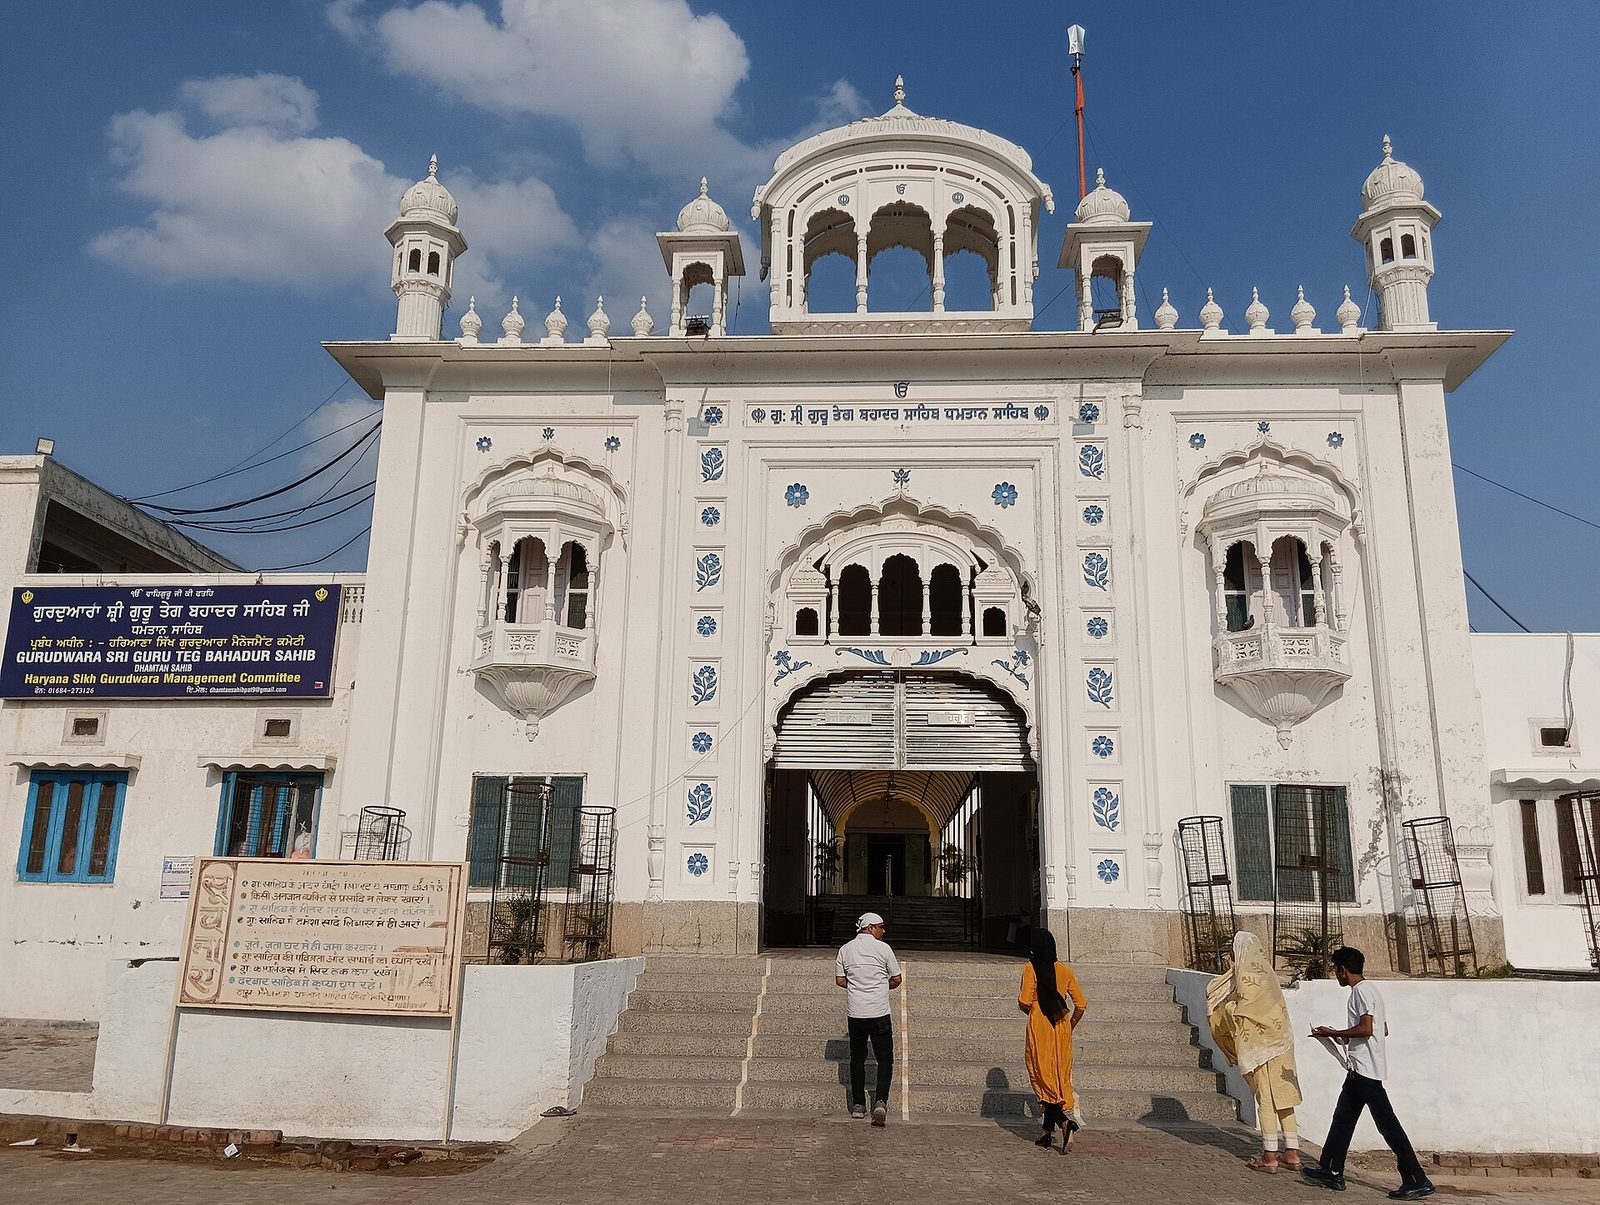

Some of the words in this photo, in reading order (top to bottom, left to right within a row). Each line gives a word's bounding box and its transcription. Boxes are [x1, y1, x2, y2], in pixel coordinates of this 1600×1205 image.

[833, 404, 854, 421] ਤੇਗ
[903, 402, 940, 421] ਸਾਹਿਬ
[992, 402, 1029, 419] ਸਾਹਿਬ
[129, 605, 154, 624] ਗੁਰੂ
[159, 601, 183, 619] ਤੇਗ
[188, 604, 239, 618] ਬਹਾਦਰ
[243, 599, 288, 618] ਸਾਹਿਬ
[292, 599, 311, 617] ਜੀ
[131, 625, 168, 635] ਧਮਤਾਨ
[171, 621, 204, 635] ਸਾਹਿਬ
[56, 635, 85, 648] ਅਧੀਨ
[108, 635, 152, 648] ਹਰਿਆਣਾ
[155, 635, 176, 647] ਸਿੱਖ
[179, 637, 229, 650] ਗੁਰਦੁਆਰਾ
[276, 633, 305, 647] ਕਮੇਟੀ
[16, 651, 102, 663] GURUDWARA
[106, 651, 129, 663] SRI
[133, 651, 171, 663] GURU
[176, 650, 201, 662] TEG
[205, 650, 271, 662] BAHADUR
[275, 649, 316, 661] SAHIB
[134, 664, 169, 673] DHAMTAN
[171, 663, 193, 672] SAHIB
[25, 673, 69, 686] Haryana
[72, 673, 97, 684] Sikh
[100, 673, 160, 684] Gurudwara
[163, 673, 237, 685] Management
[240, 672, 301, 683] Committee
[387, 917, 397, 928] ही
